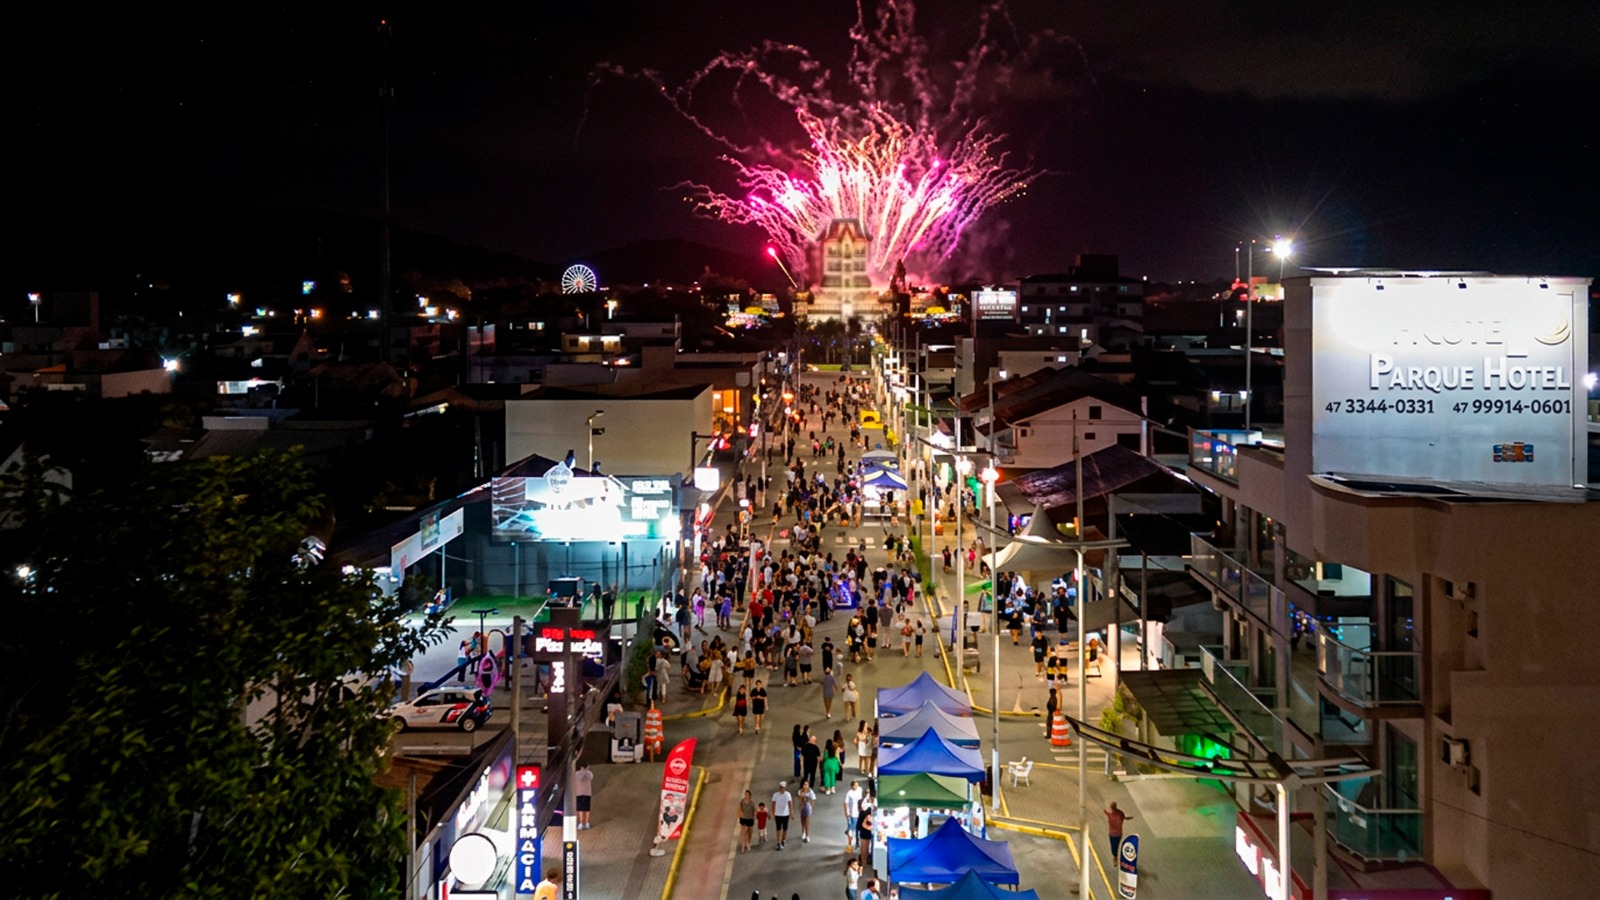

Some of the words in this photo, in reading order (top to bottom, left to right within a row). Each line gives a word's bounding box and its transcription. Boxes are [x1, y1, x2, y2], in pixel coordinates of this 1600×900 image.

[1370, 352, 1474, 393] PARQUE
[1483, 356, 1571, 391] HOTEL
[1325, 401, 1342, 414] 47
[1345, 399, 1435, 414] 3344-0331
[1453, 401, 1469, 414] 47
[1472, 399, 1571, 415] 99914-0601
